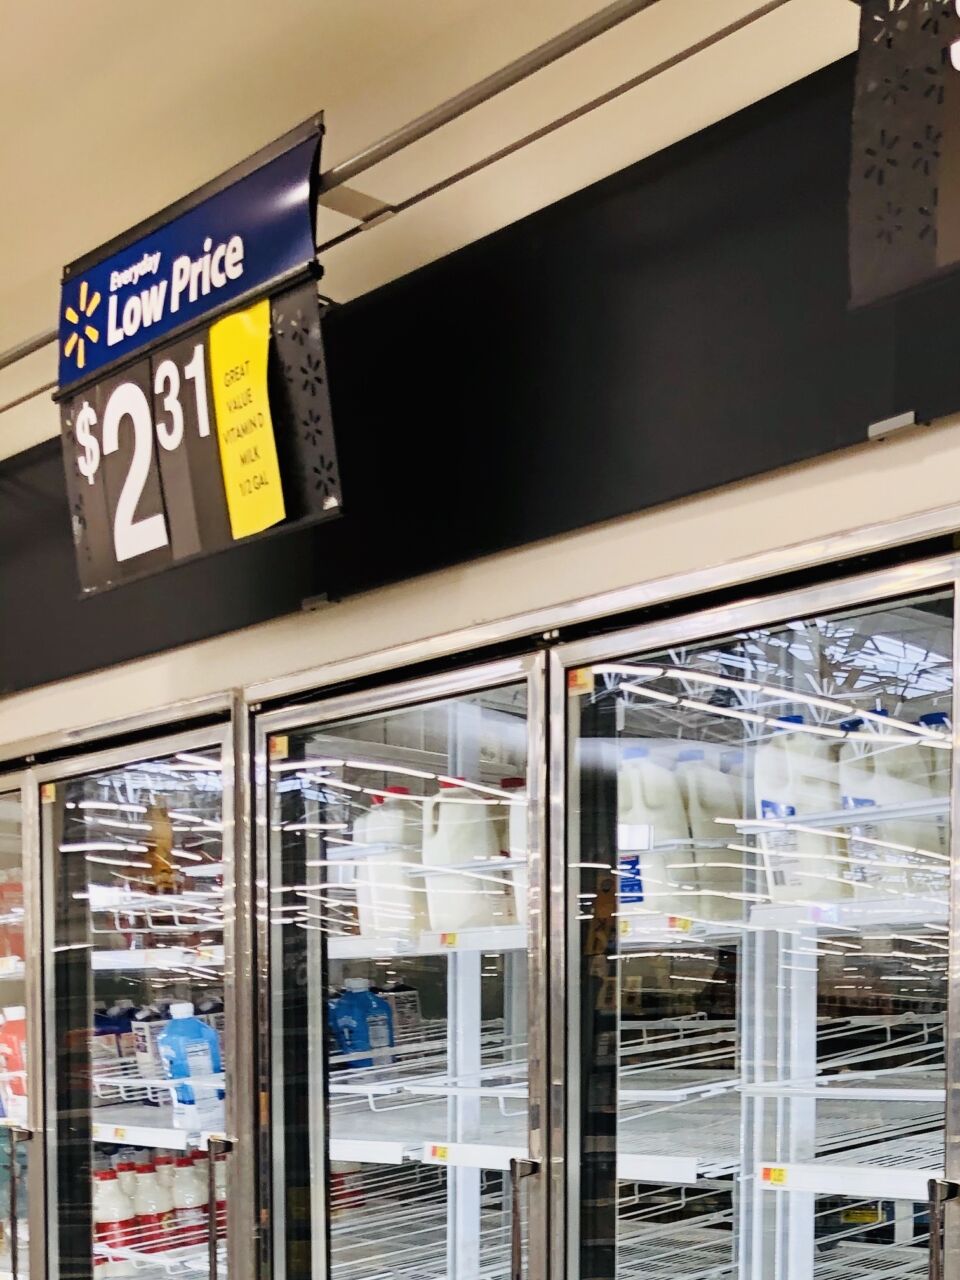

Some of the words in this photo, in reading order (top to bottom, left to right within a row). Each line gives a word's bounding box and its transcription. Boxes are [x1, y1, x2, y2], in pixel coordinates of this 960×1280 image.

[110, 251, 161, 292] Everyday
[107, 280, 168, 346] Low
[170, 235, 244, 313] Price
[223, 360, 250, 387] GREAT
[226, 388, 253, 412] VALUE
[222, 417, 257, 444] VITAMIN
[240, 445, 261, 465] MILK
[252, 471, 269, 490] GAL
